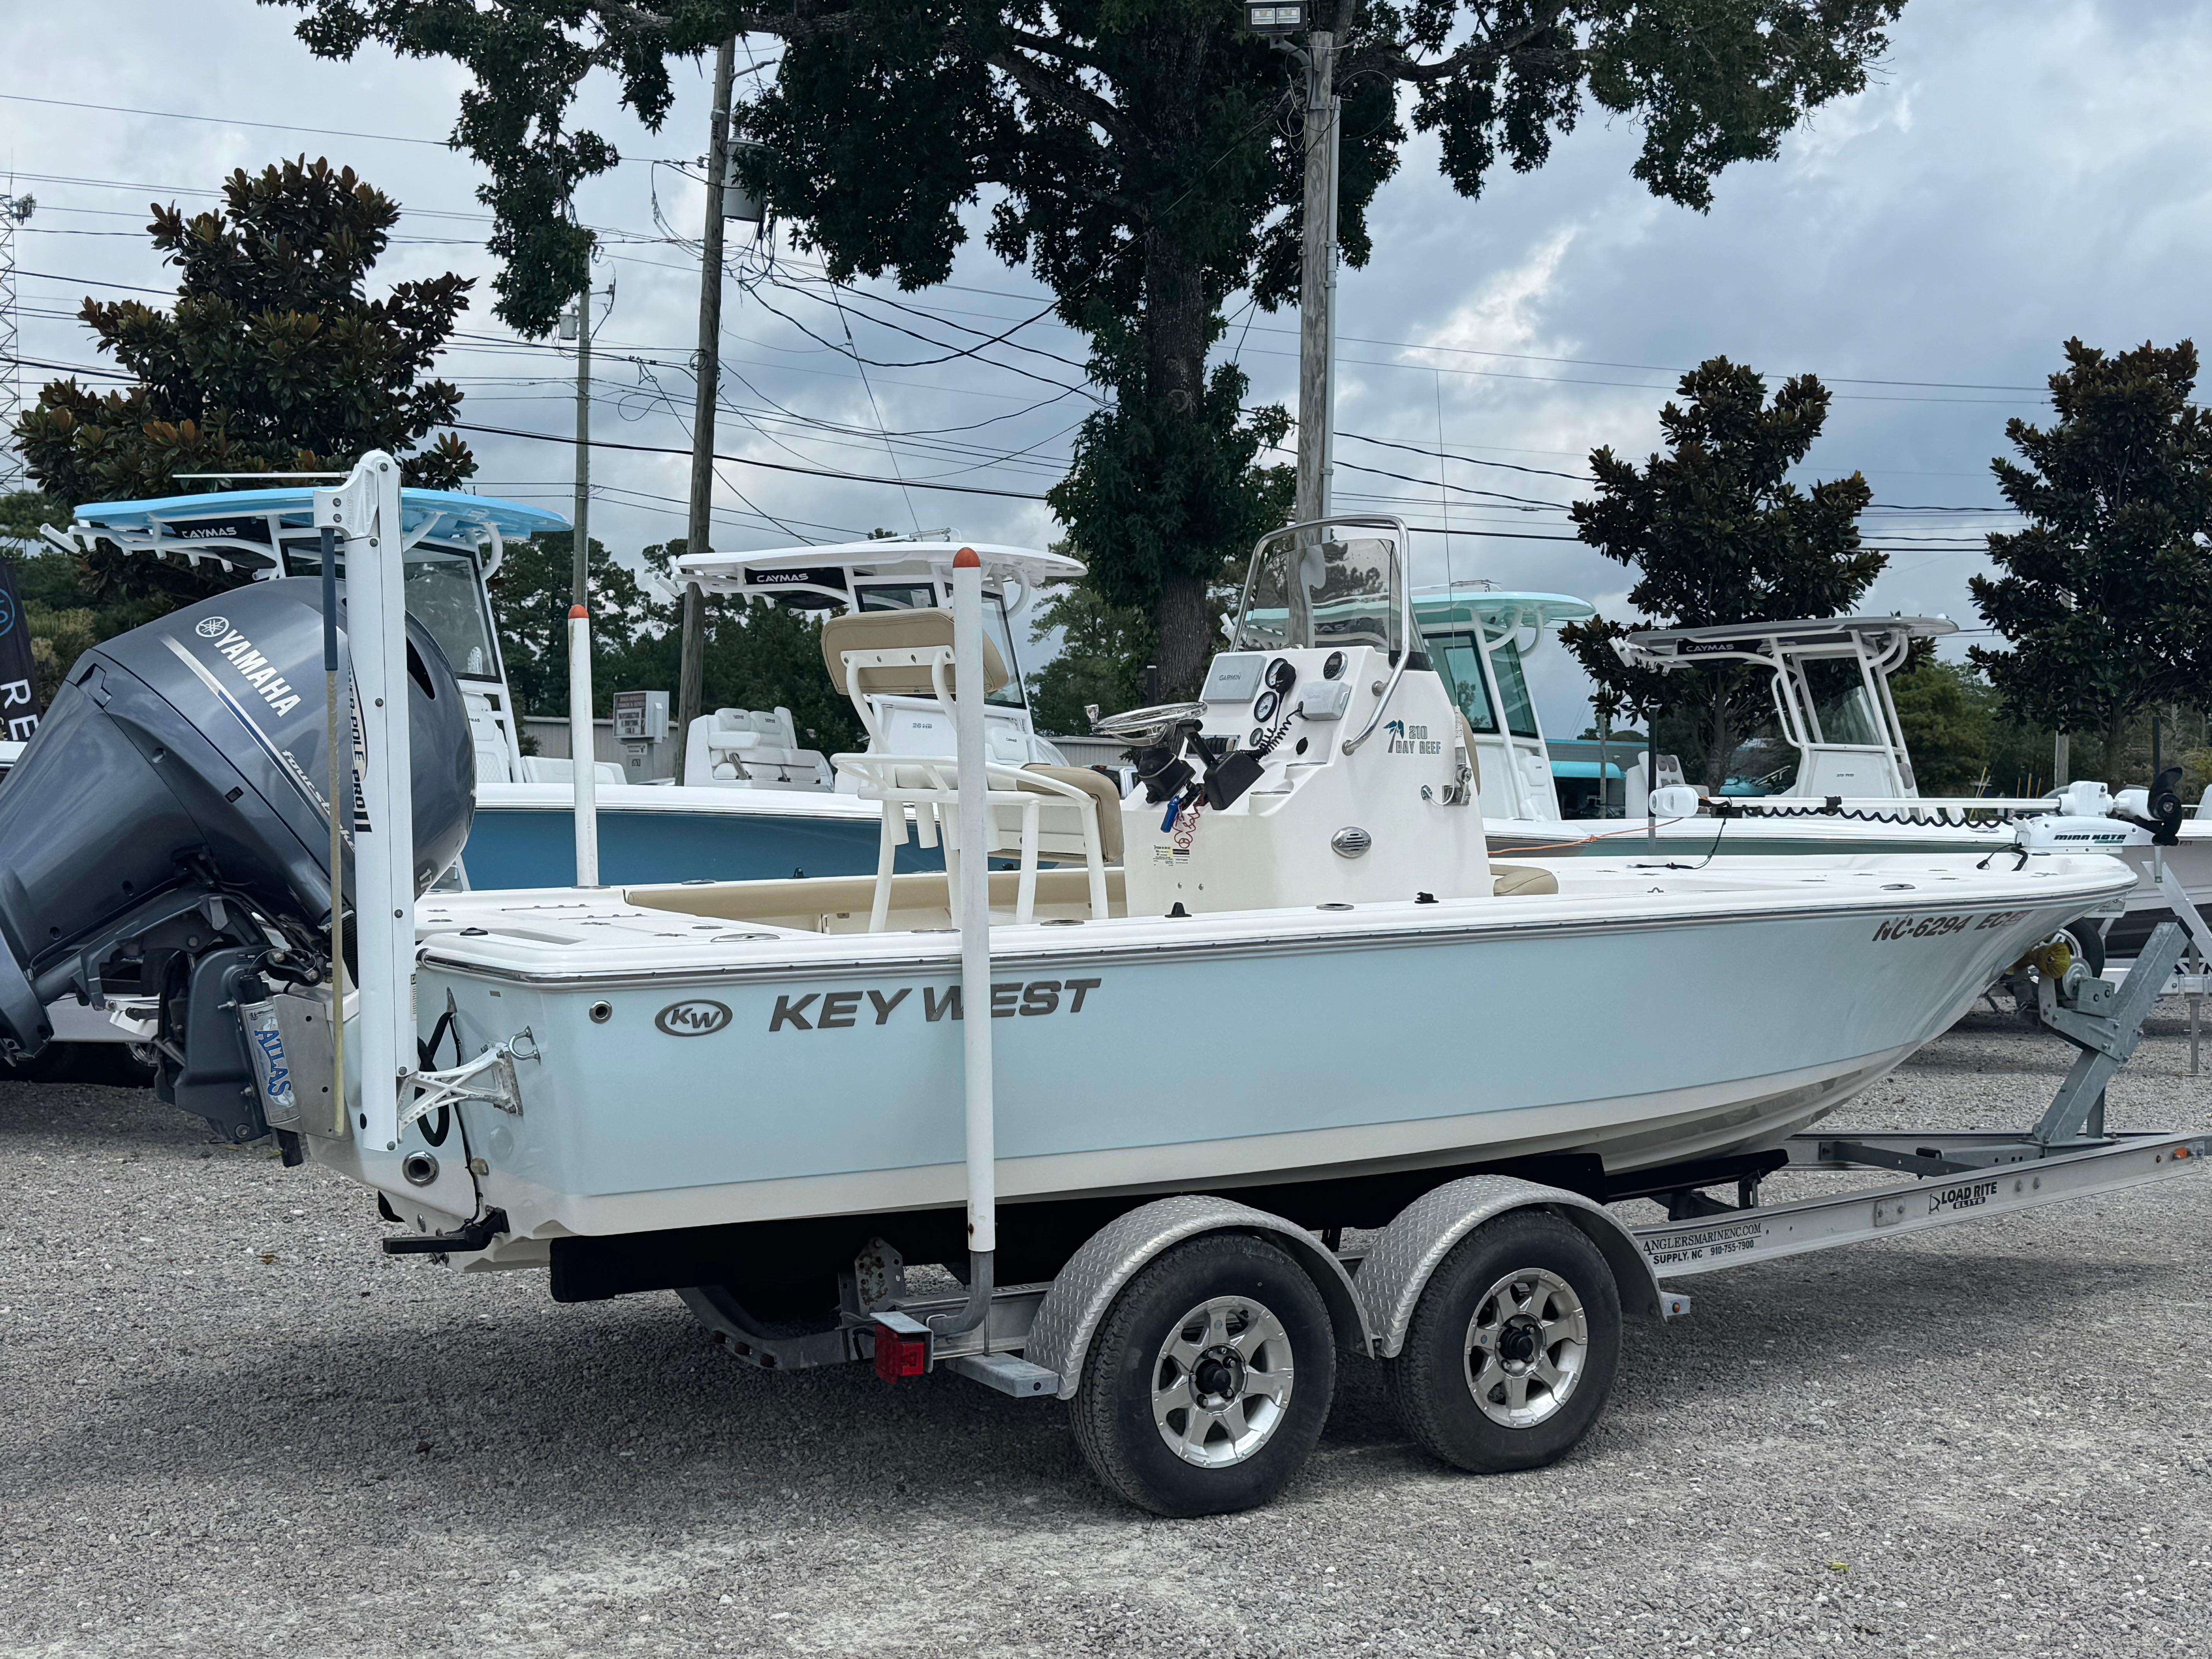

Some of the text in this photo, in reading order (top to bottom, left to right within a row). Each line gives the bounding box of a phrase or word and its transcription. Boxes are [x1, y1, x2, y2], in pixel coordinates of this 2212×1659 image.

[182, 527, 237, 538] CAYMAS
[756, 573, 809, 582] CAYMAS
[214, 629, 301, 717] YAMAHA
[1409, 725, 1428, 739] 210
[1396, 740, 1441, 754] BAY REEF
[1872, 914, 1974, 941] NC-6294
[670, 1008, 720, 1029] KW
[769, 988, 912, 1032] KEY
[254, 1030, 292, 1097] ATLAS
[1941, 1182, 1997, 1204] LOAD RITE
[1956, 1197, 1983, 1208] ELITE
[1644, 1223, 1761, 1255] ANGLERSMARINENC.COM
[1654, 1239, 1754, 1264] SUPPLY, NC 910-755-7900
